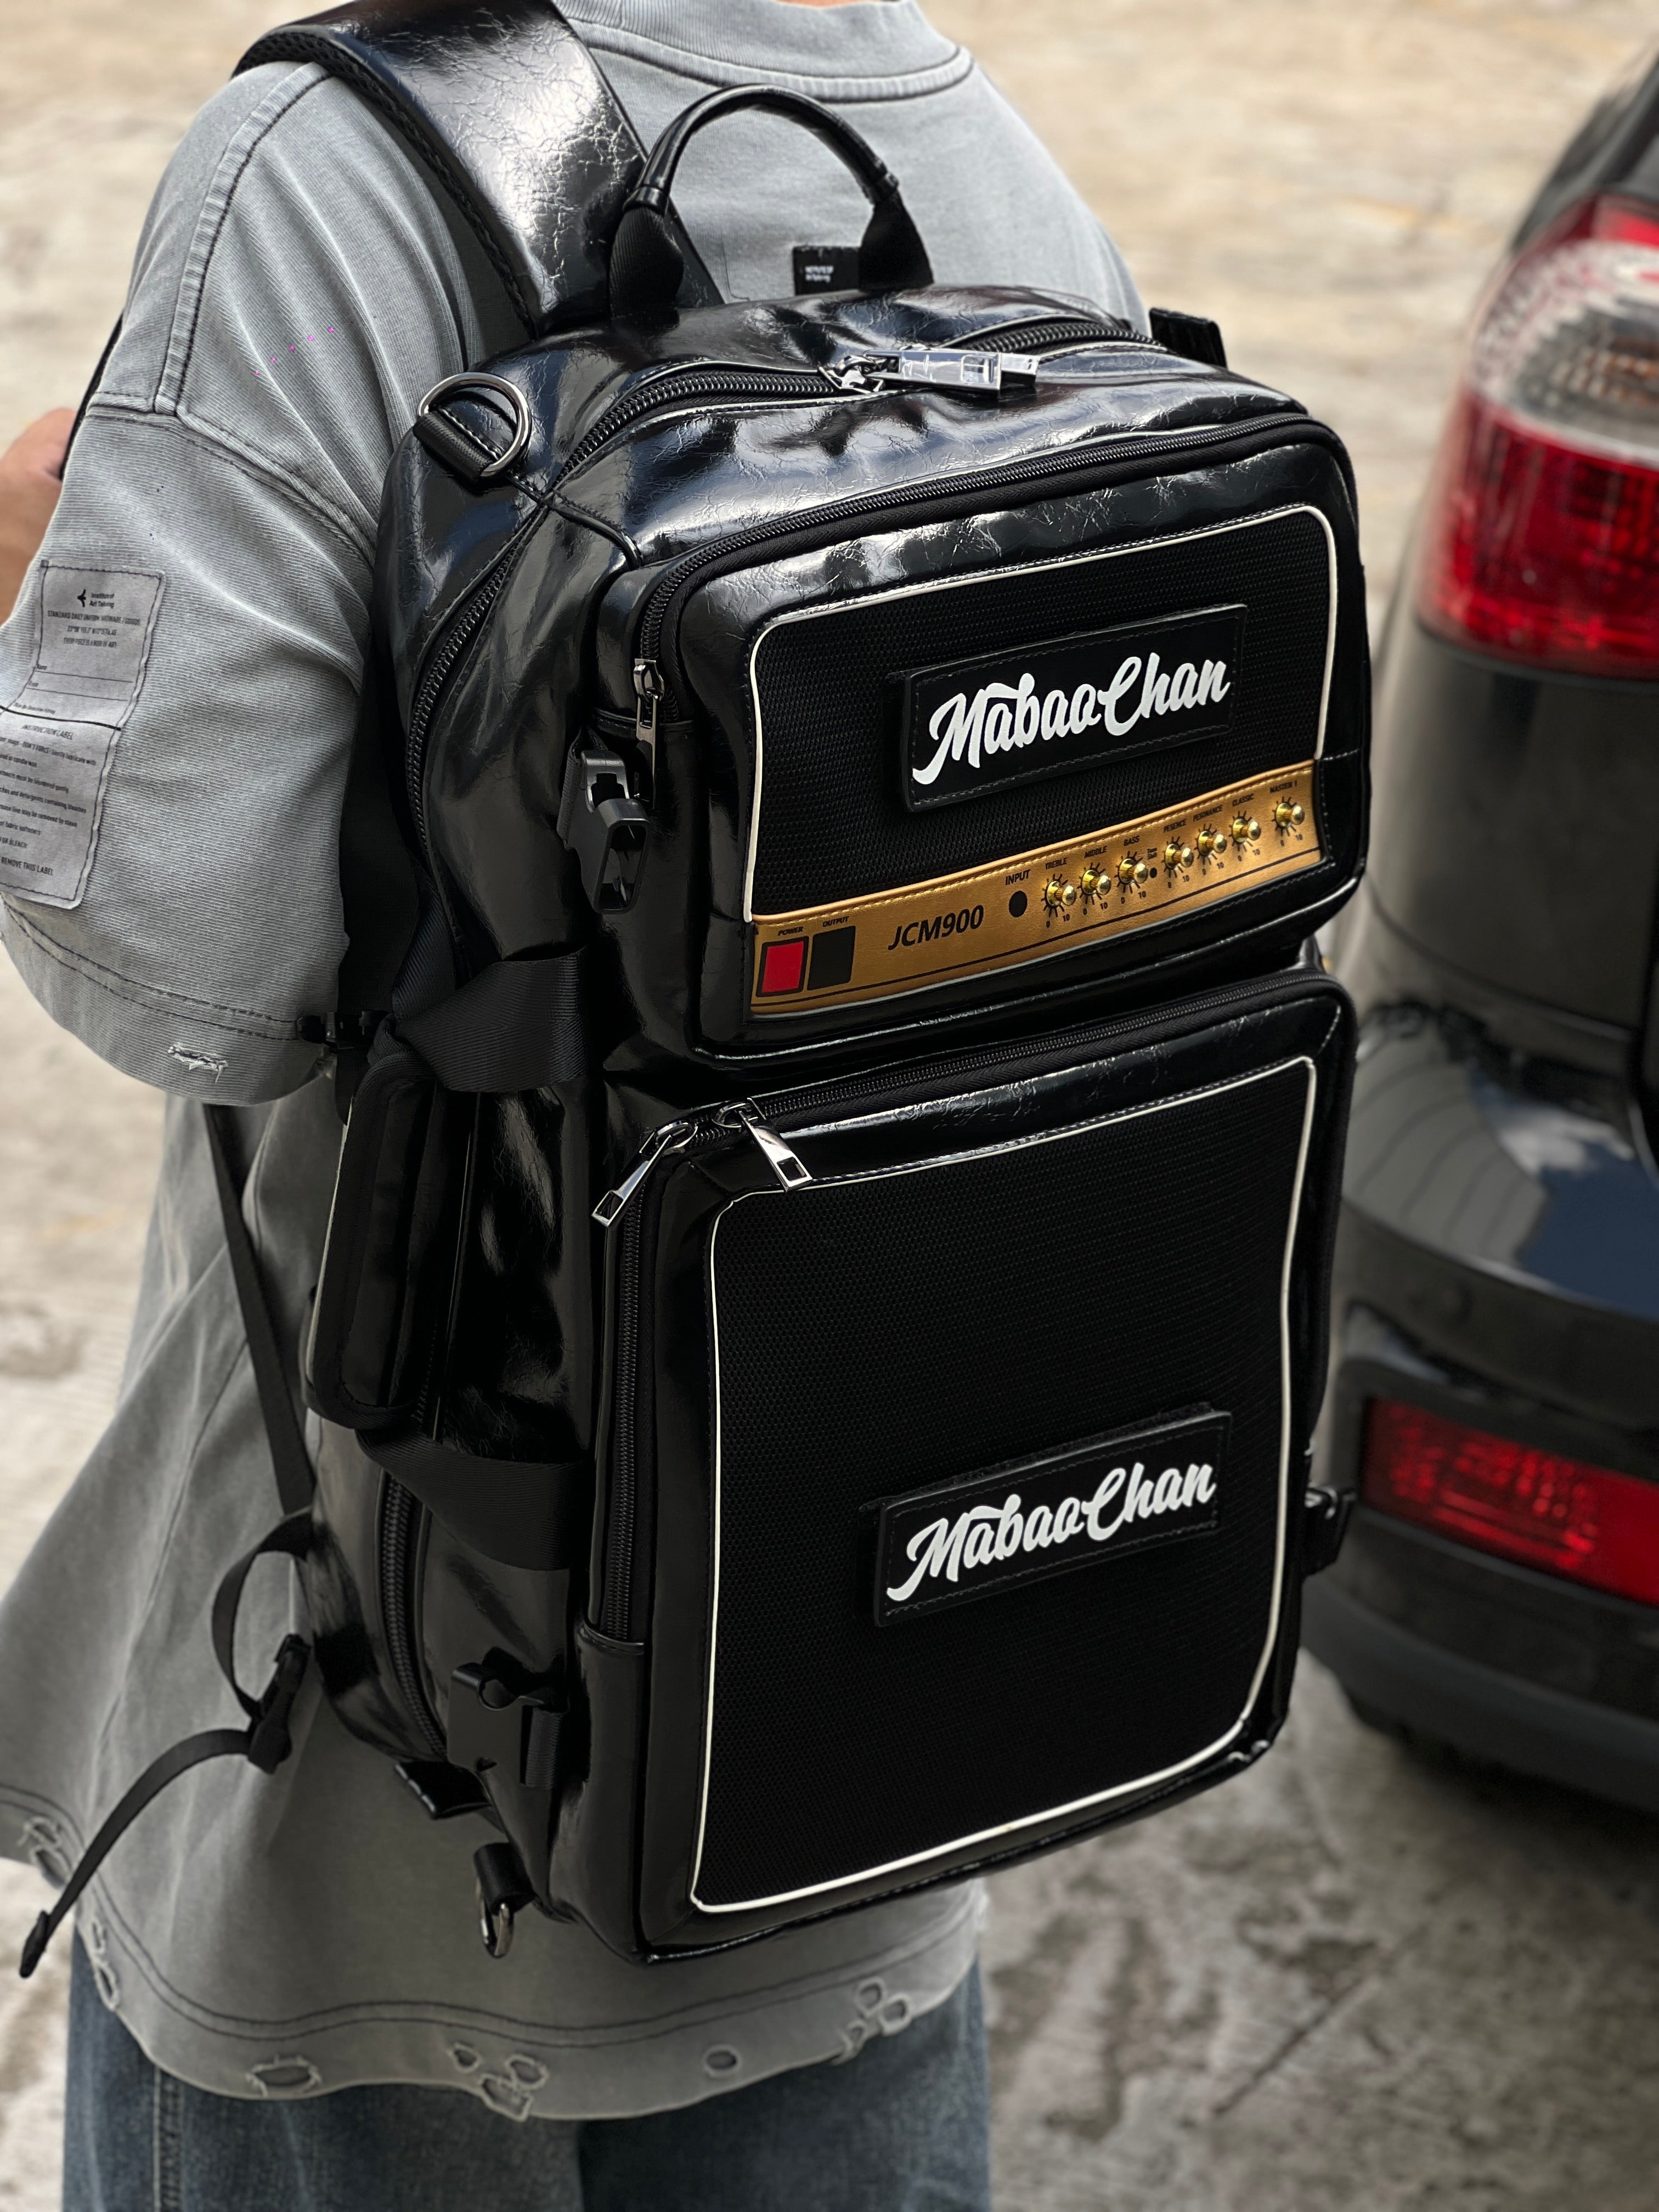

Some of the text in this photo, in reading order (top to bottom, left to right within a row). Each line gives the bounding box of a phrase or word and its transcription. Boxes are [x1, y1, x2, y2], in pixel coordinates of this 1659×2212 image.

[57, 730, 75, 740] LABEL
[1269, 781, 1293, 793] MASTER
[1232, 793, 1254, 806] CLASSIC
[1124, 836, 1139, 846] BASS
[1084, 845, 1108, 859] MIDDLE
[1, 857, 54, 876] REMOVE THIS LABEL
[1045, 857, 1068, 870] TREBLE
[1005, 869, 1031, 885] INPUT
[1182, 874, 1190, 883] 10
[822, 916, 850, 927] OUTPUT
[1063, 913, 1070, 922] 10
[777, 927, 804, 936] POWER
[888, 905, 984, 950] JCM900
